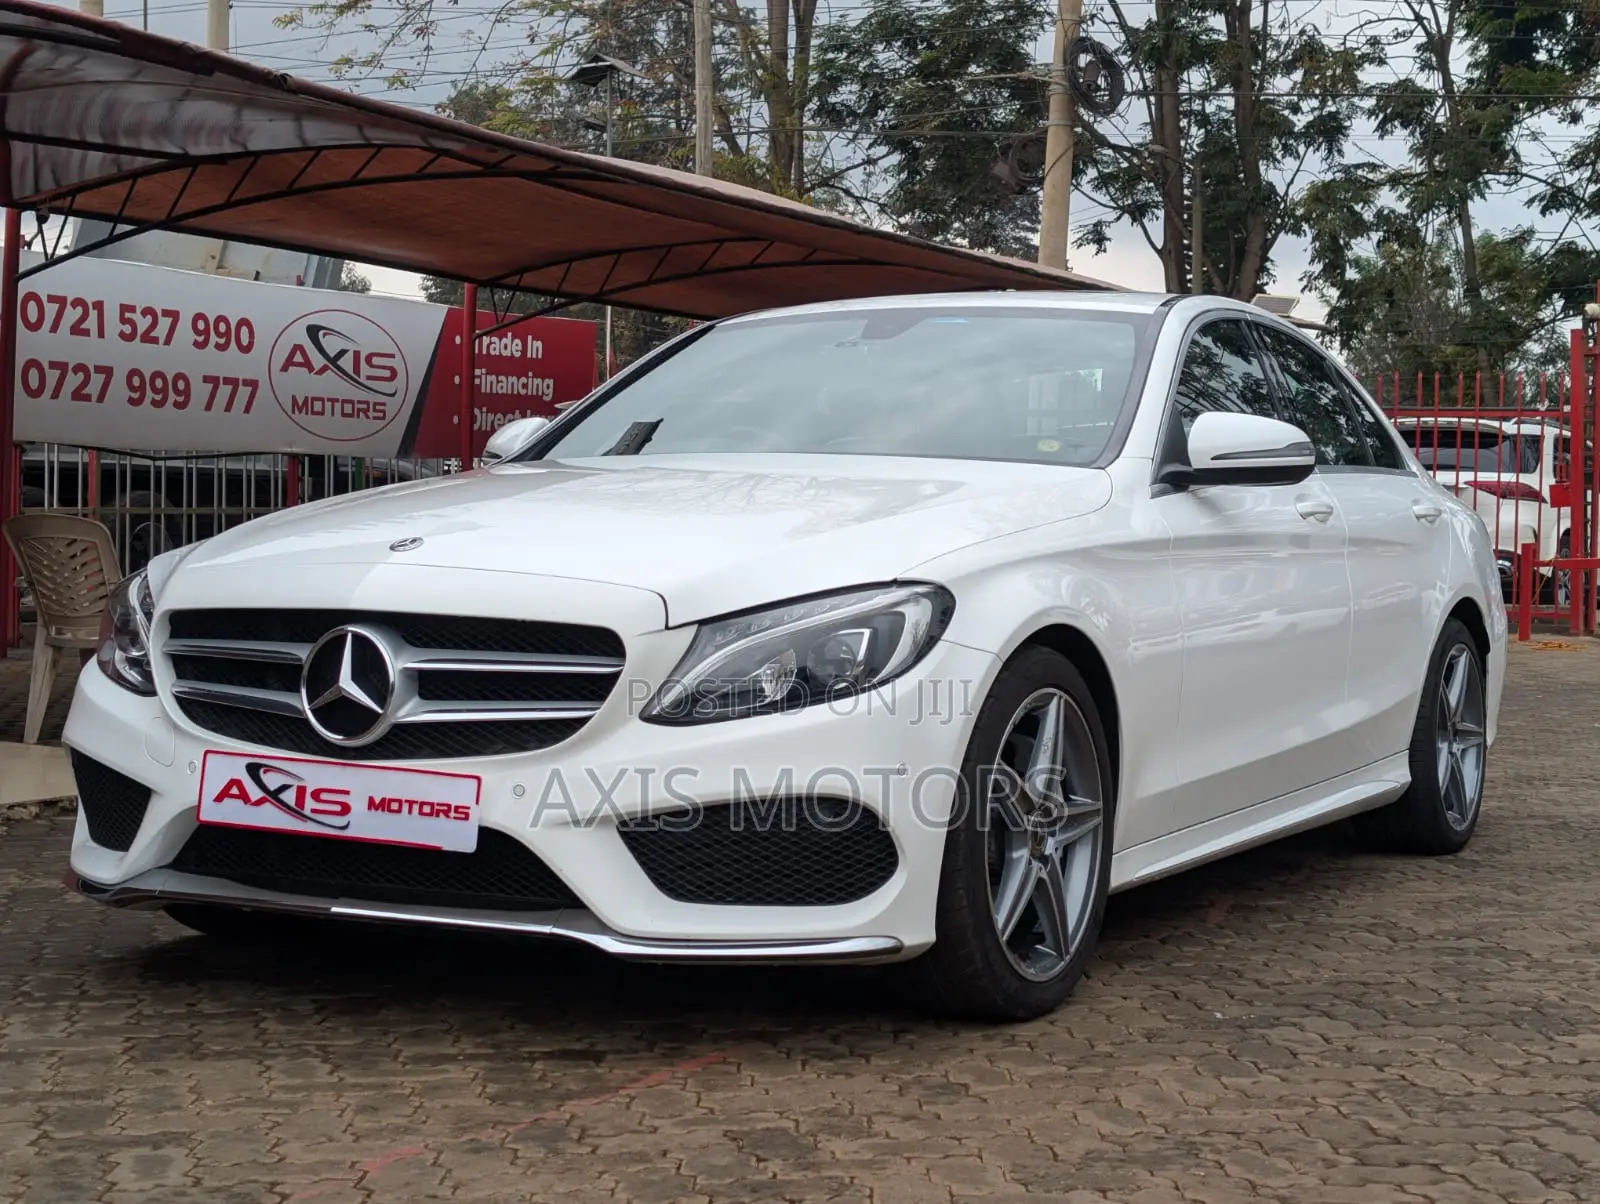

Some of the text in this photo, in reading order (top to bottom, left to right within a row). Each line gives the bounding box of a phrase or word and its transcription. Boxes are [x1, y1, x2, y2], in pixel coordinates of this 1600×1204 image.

[20, 291, 256, 355] 0721 527 990
[527, 335, 543, 359] In
[21, 358, 260, 415] 0727 999 777
[279, 324, 399, 398] AXIS
[291, 394, 388, 421] MOTORS
[213, 762, 471, 831] AXIS MOTORS
